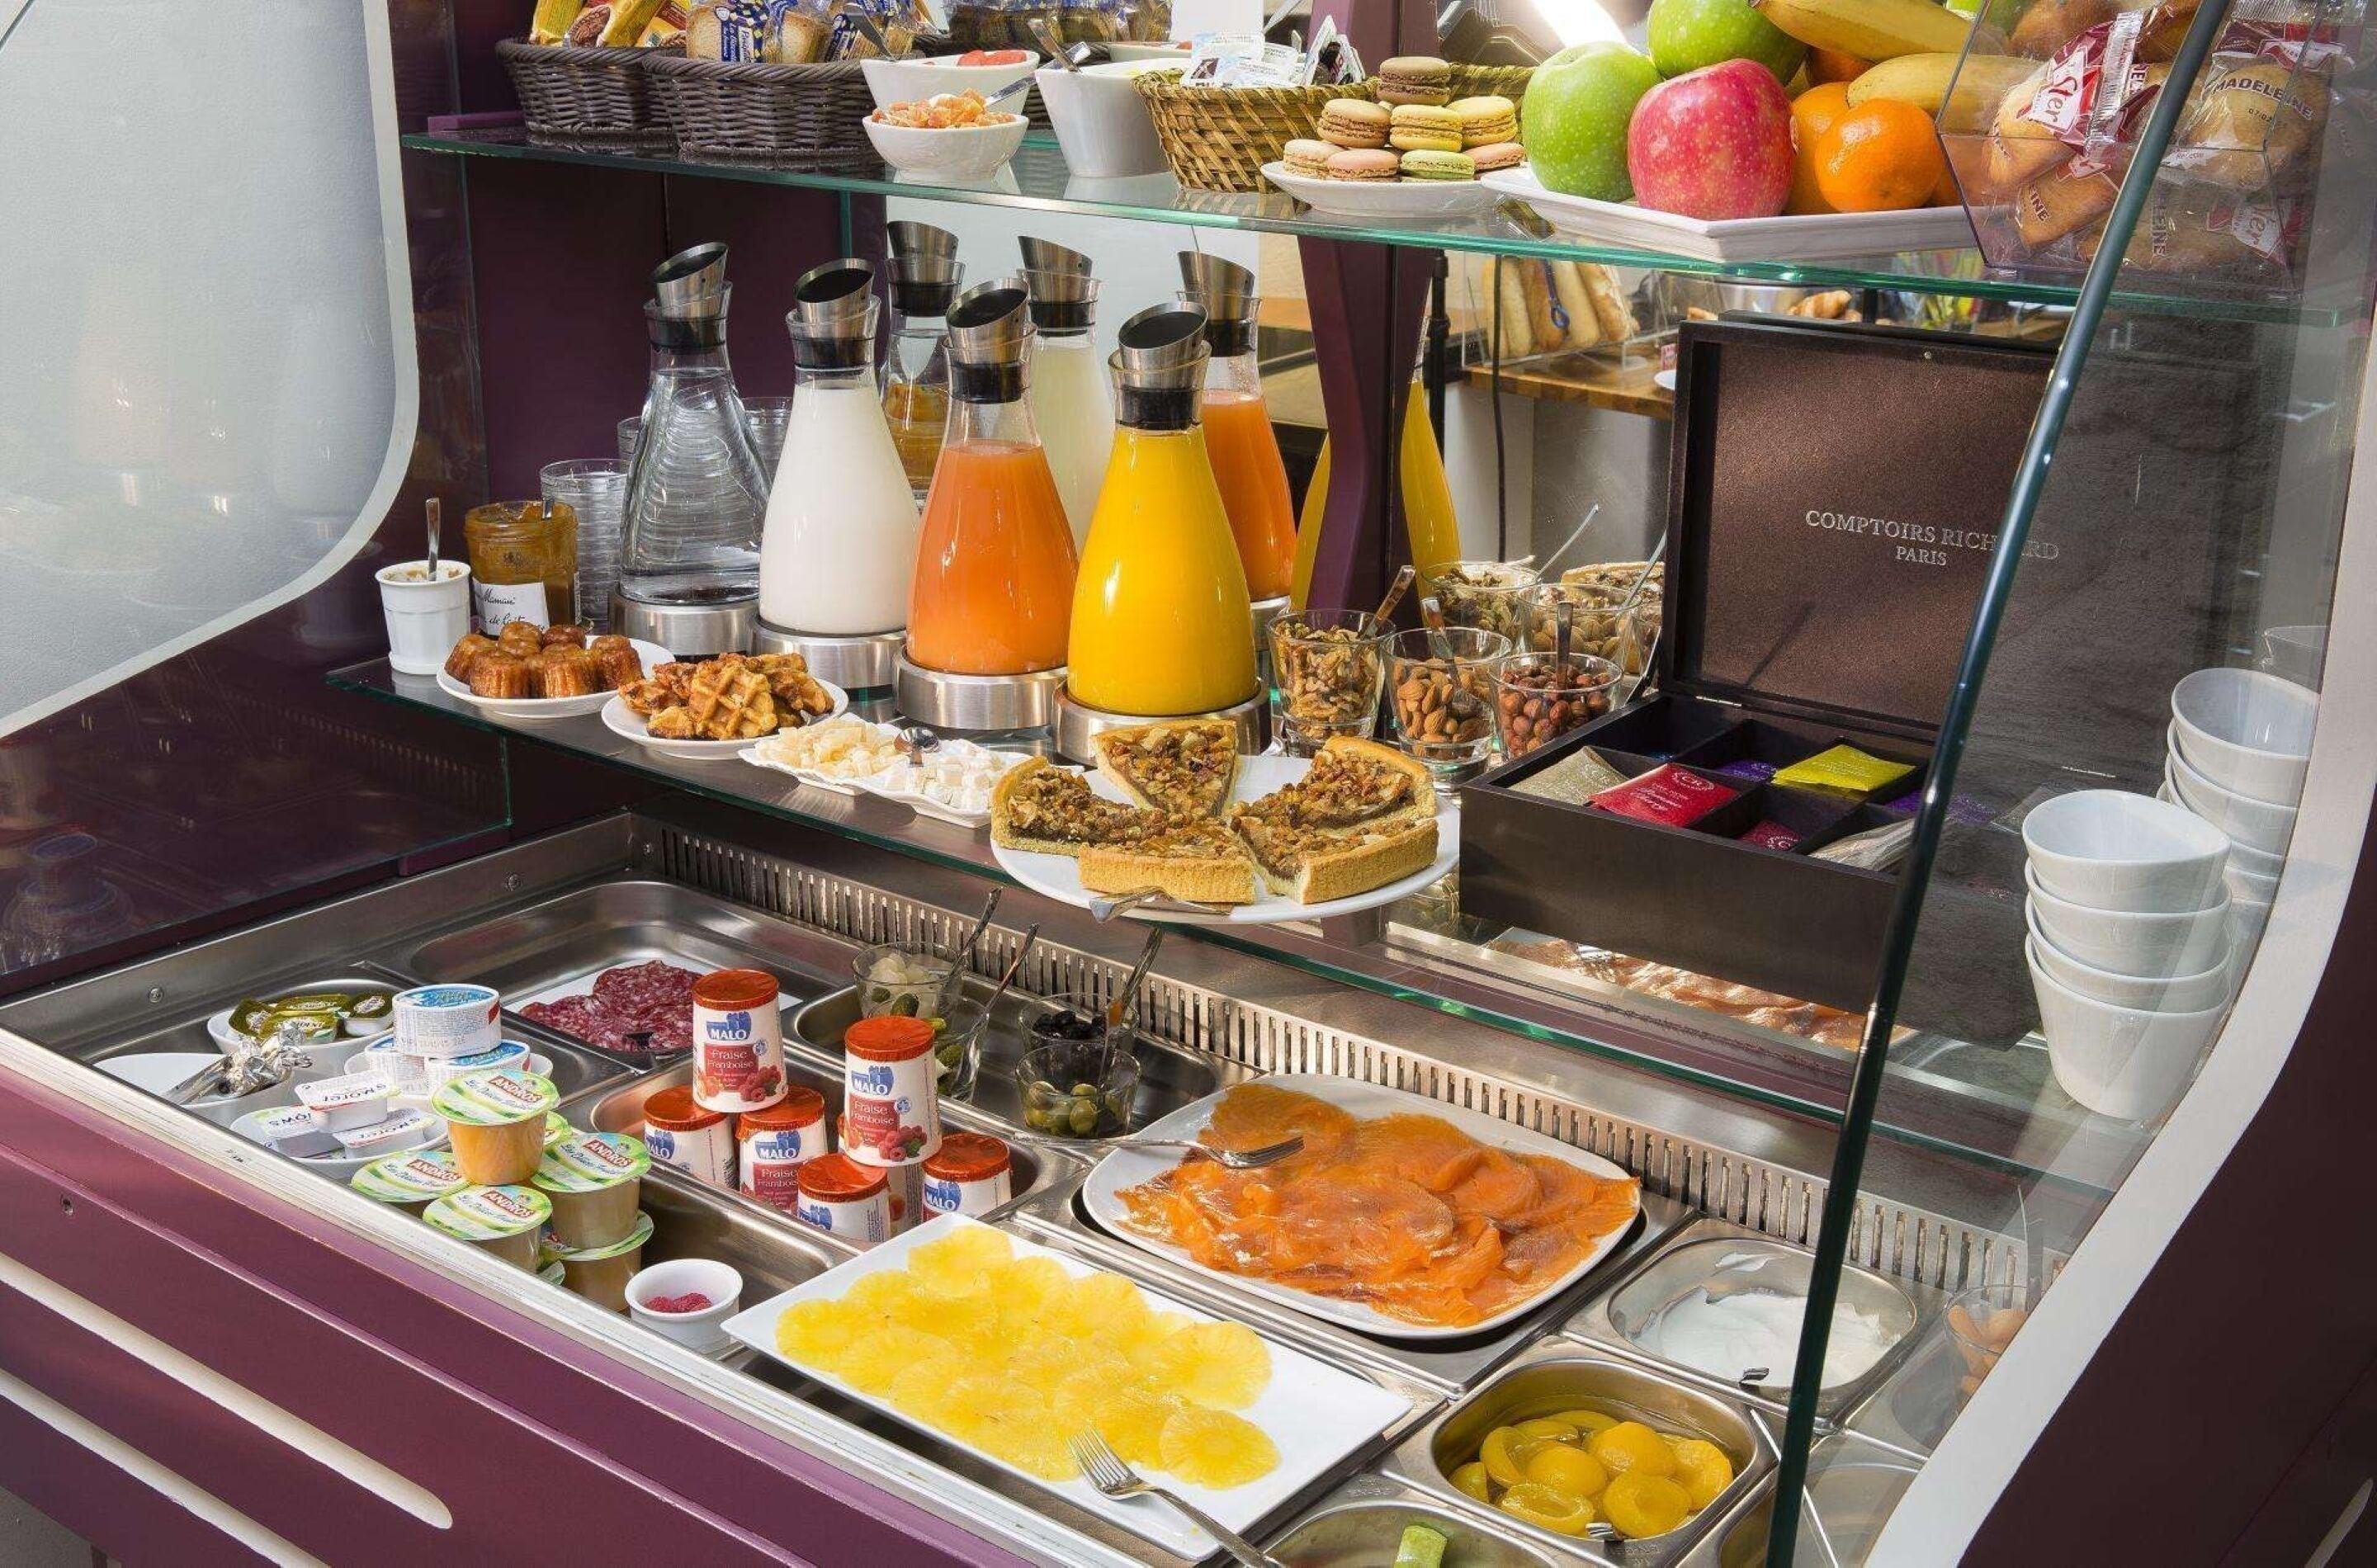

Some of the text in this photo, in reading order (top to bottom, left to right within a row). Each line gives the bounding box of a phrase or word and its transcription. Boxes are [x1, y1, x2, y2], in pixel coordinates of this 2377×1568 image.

[1805, 509, 2060, 560] COMPTOIRS RICHRD
[1896, 545, 1948, 567] PARIS
[711, 1028, 748, 1041] MALO
[494, 1076, 542, 1103] ANDROS
[853, 1078, 888, 1095] MALO
[853, 1100, 889, 1114] Fraise
[587, 1141, 633, 1168] ANDROS
[759, 1147, 796, 1159] MALO
[411, 1160, 462, 1181] ANDROS
[484, 1191, 534, 1217] ANDROS
[926, 1191, 957, 1211] MALO
